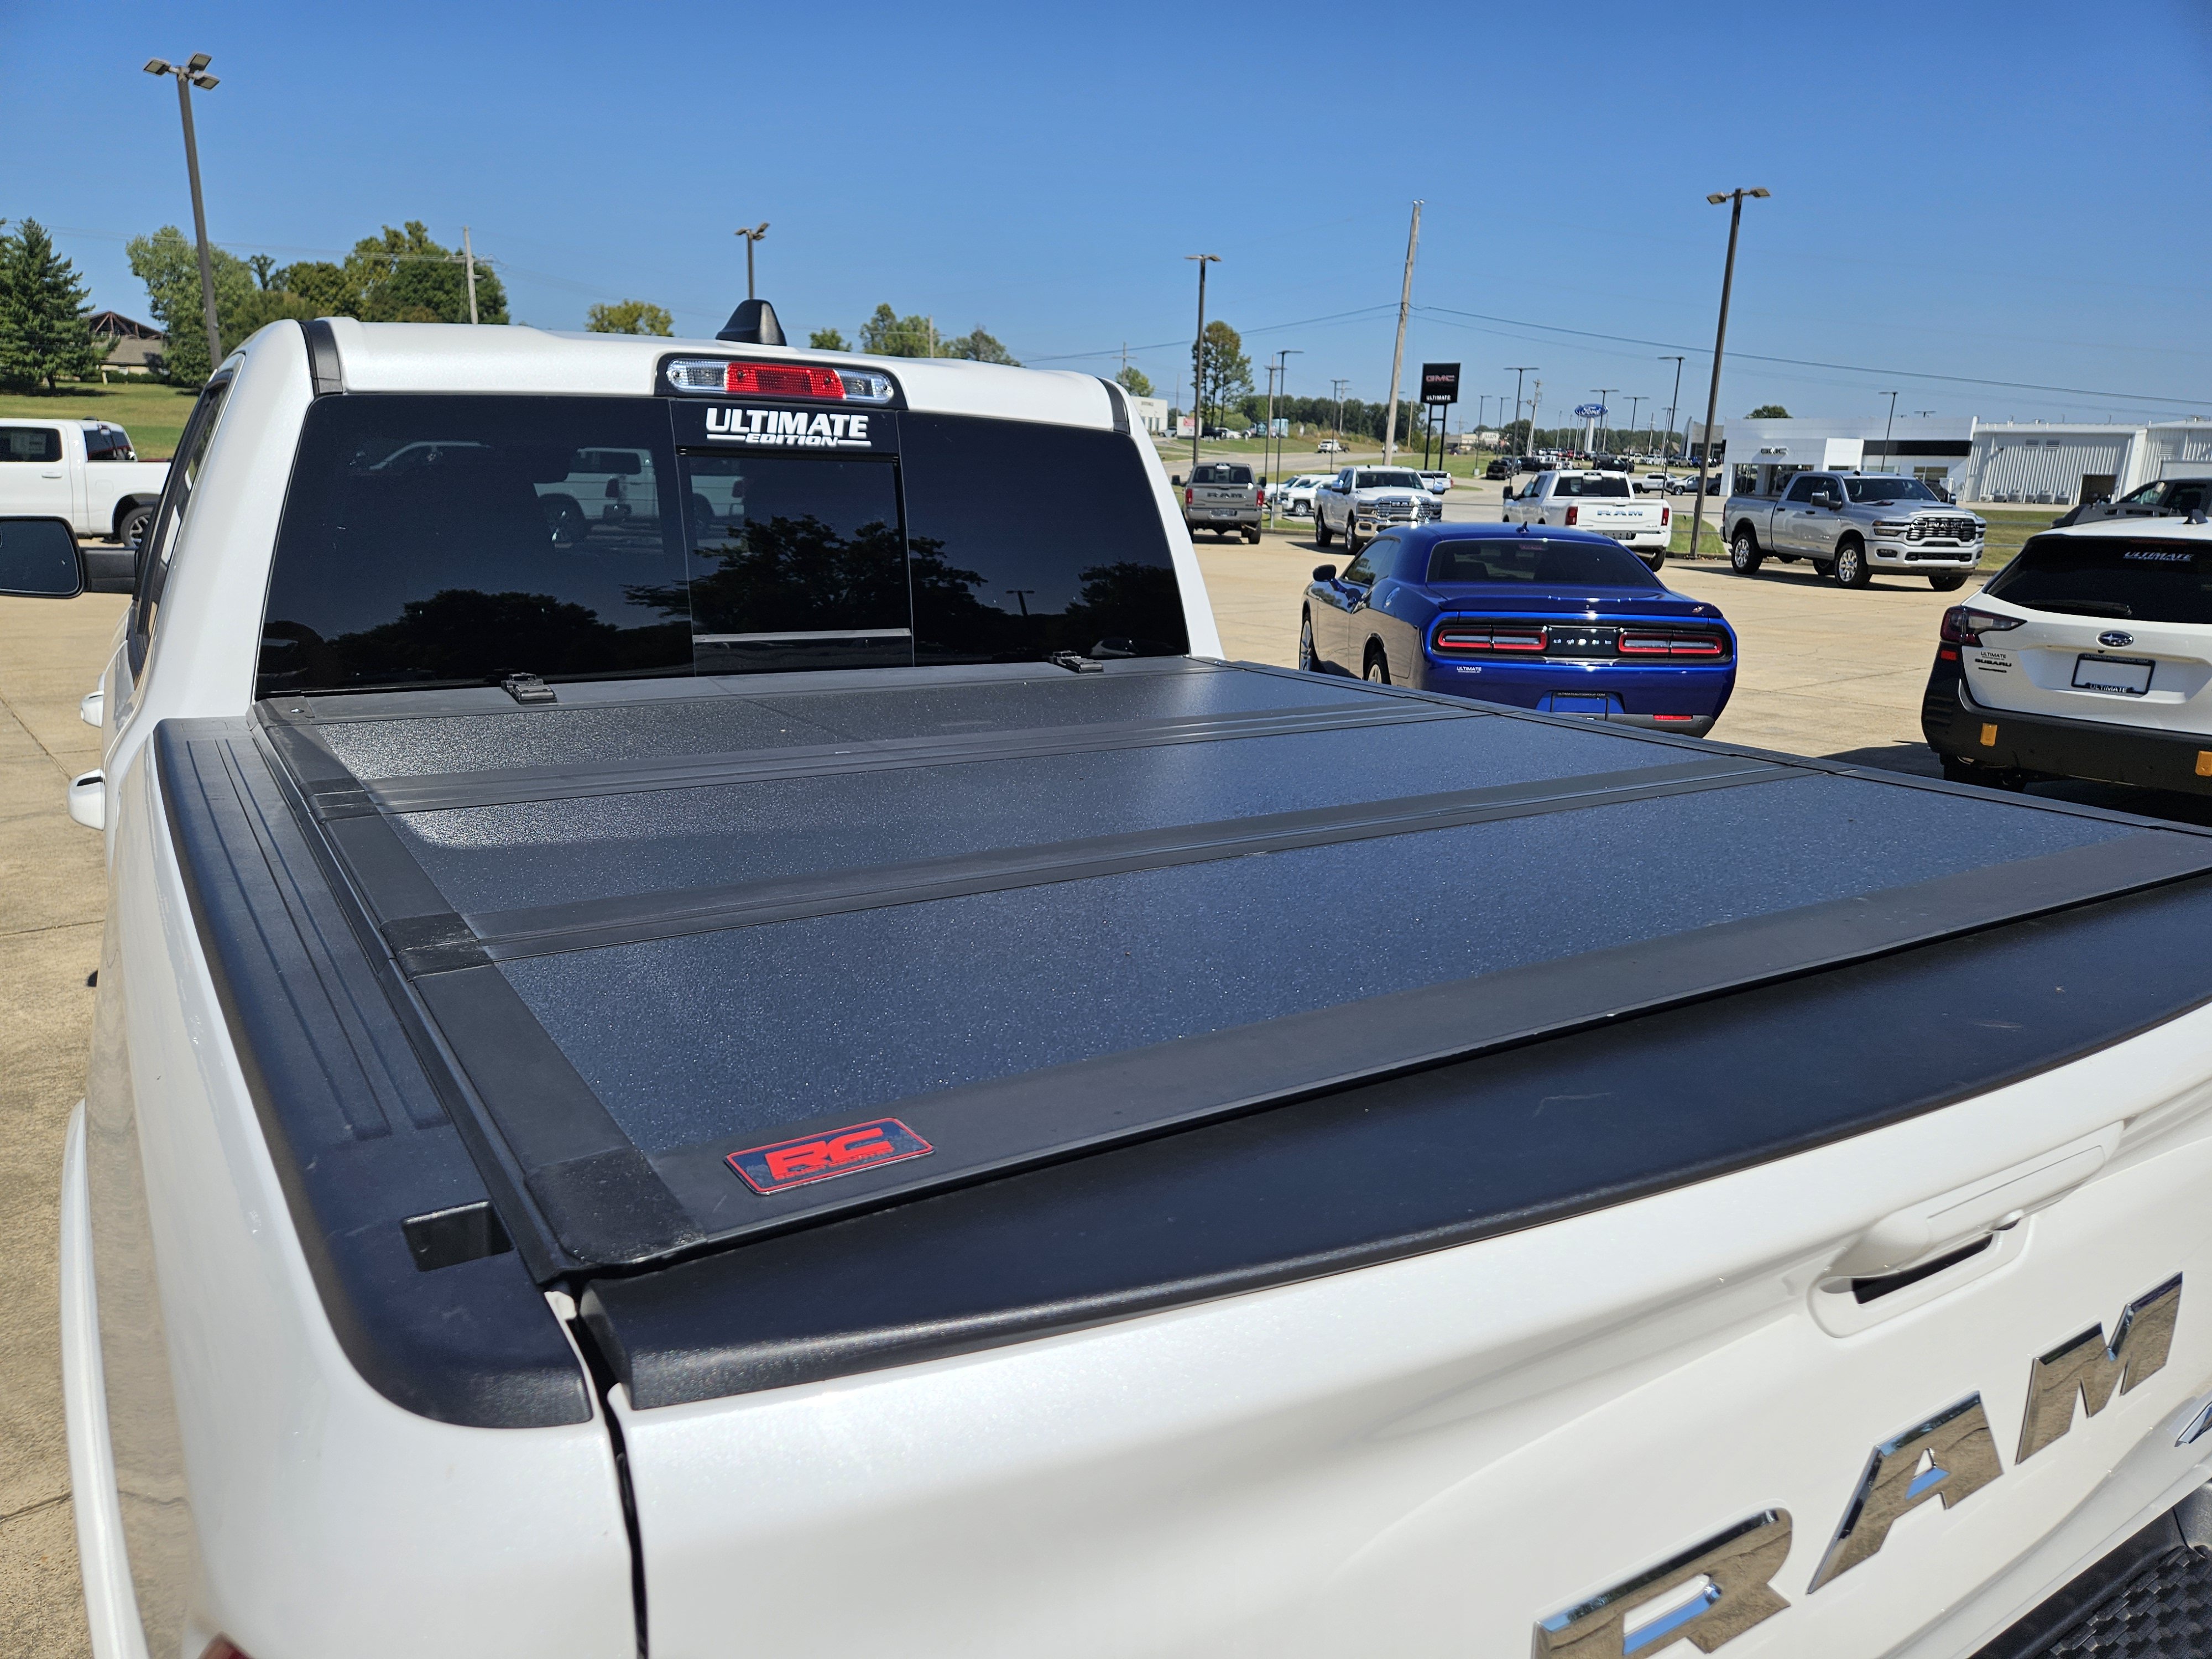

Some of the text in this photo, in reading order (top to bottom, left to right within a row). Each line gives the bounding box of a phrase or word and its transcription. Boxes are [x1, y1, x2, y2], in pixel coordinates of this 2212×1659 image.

[1582, 406, 1601, 415] Ford
[706, 408, 869, 439] ULTIMATE
[745, 433, 839, 447] EDITION
[2124, 551, 2194, 561] ULTIMATE
[1975, 658, 2012, 667] SUBARU
[2090, 684, 2128, 693] ULTIMATE
[765, 1127, 893, 1178] RC
[1530, 1271, 2183, 1659] RAM
